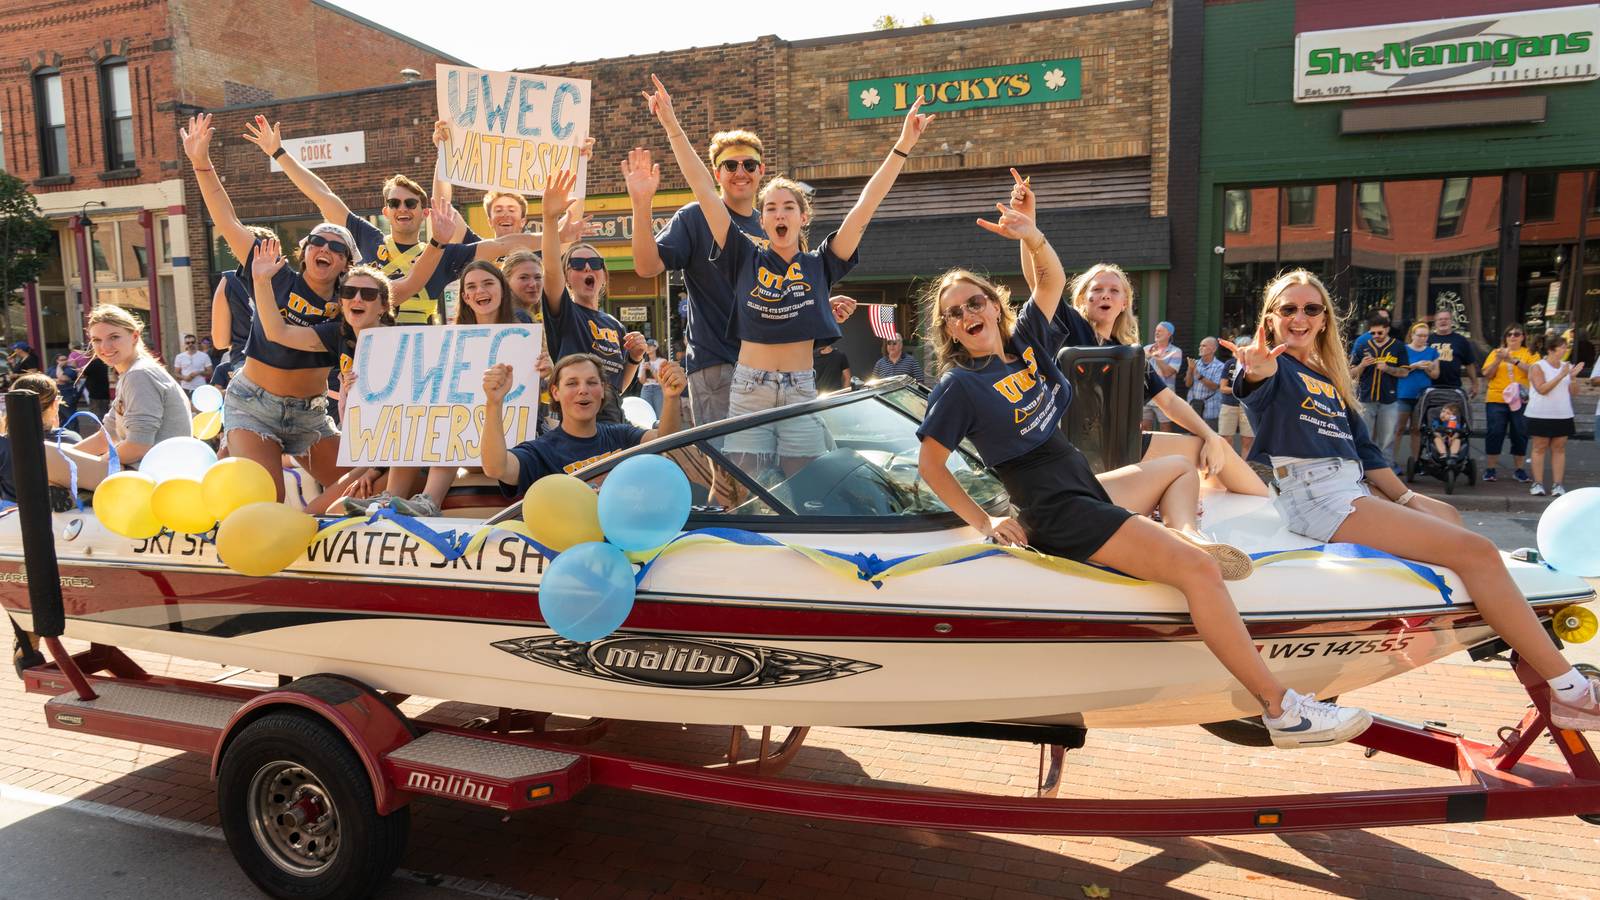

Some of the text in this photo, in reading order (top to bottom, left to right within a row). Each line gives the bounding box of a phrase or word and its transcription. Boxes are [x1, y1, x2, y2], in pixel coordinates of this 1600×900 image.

[447, 71, 581, 140] UWEC
[893, 73, 1031, 111] LUCKY'S
[300, 143, 332, 161] COOKE
[443, 127, 581, 192] WATERSKI
[357, 328, 530, 404] UWEC
[306, 531, 420, 568] WATER
[604, 647, 741, 675] malibu
[1269, 642, 1320, 659] WS
[407, 771, 493, 801] malibu
